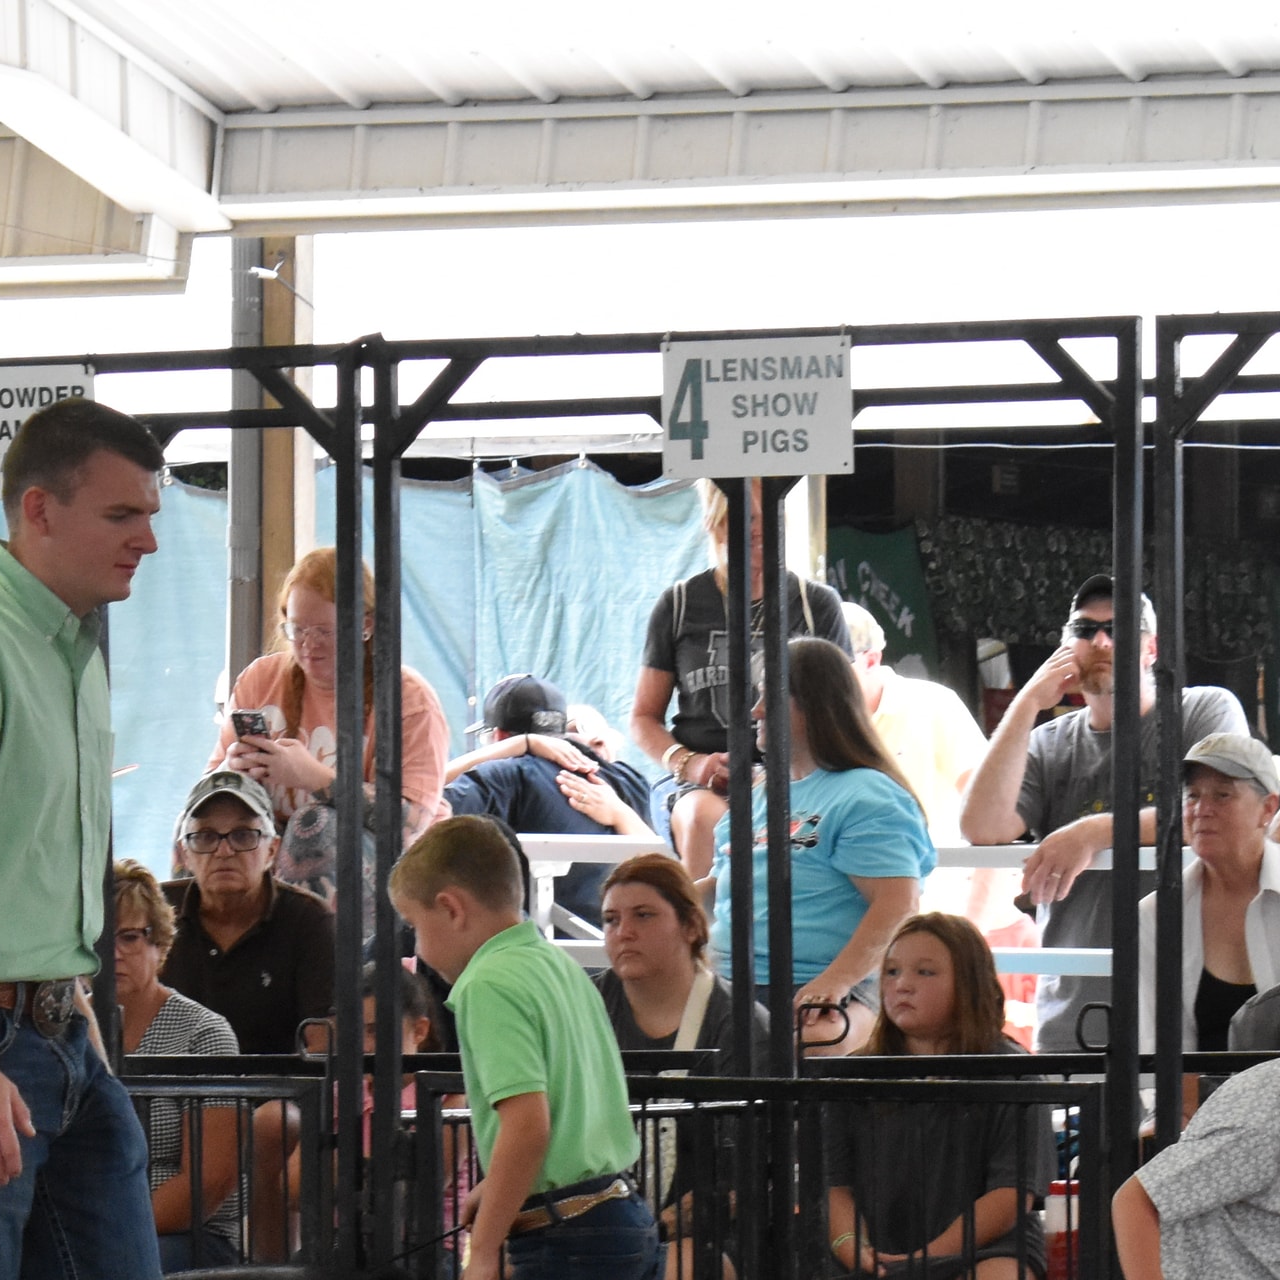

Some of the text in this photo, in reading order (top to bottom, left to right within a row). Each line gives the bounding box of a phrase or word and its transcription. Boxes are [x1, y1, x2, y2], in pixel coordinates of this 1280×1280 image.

[705, 354, 844, 382] LENSMAN
[668, 358, 709, 460] 4
[732, 392, 818, 418] SHOW
[743, 429, 809, 453] PIGS
